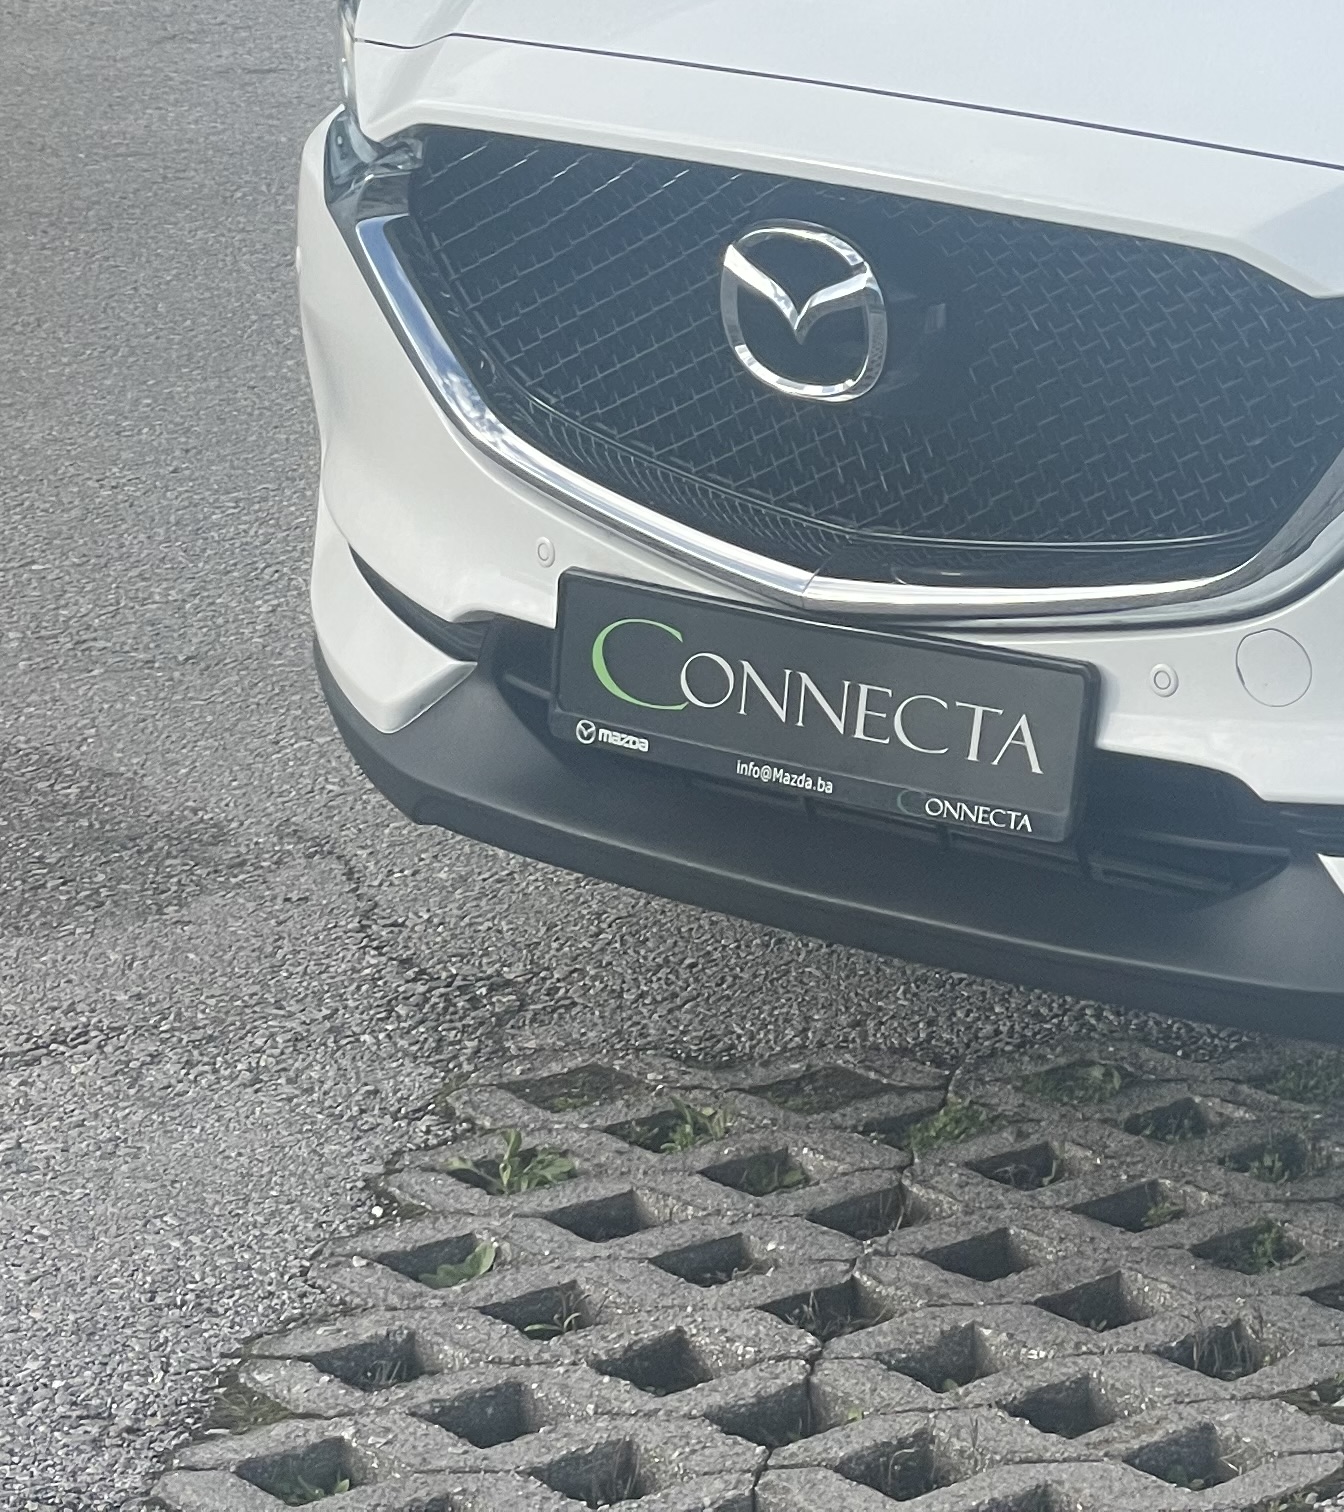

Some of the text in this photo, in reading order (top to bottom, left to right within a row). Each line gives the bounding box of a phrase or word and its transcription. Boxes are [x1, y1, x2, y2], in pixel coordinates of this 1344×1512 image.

[591, 617, 1044, 775] CONNECTA
[598, 727, 650, 753] mazda
[735, 759, 833, 794] info@Mazda.ba
[896, 789, 1033, 833] CONNECTA
